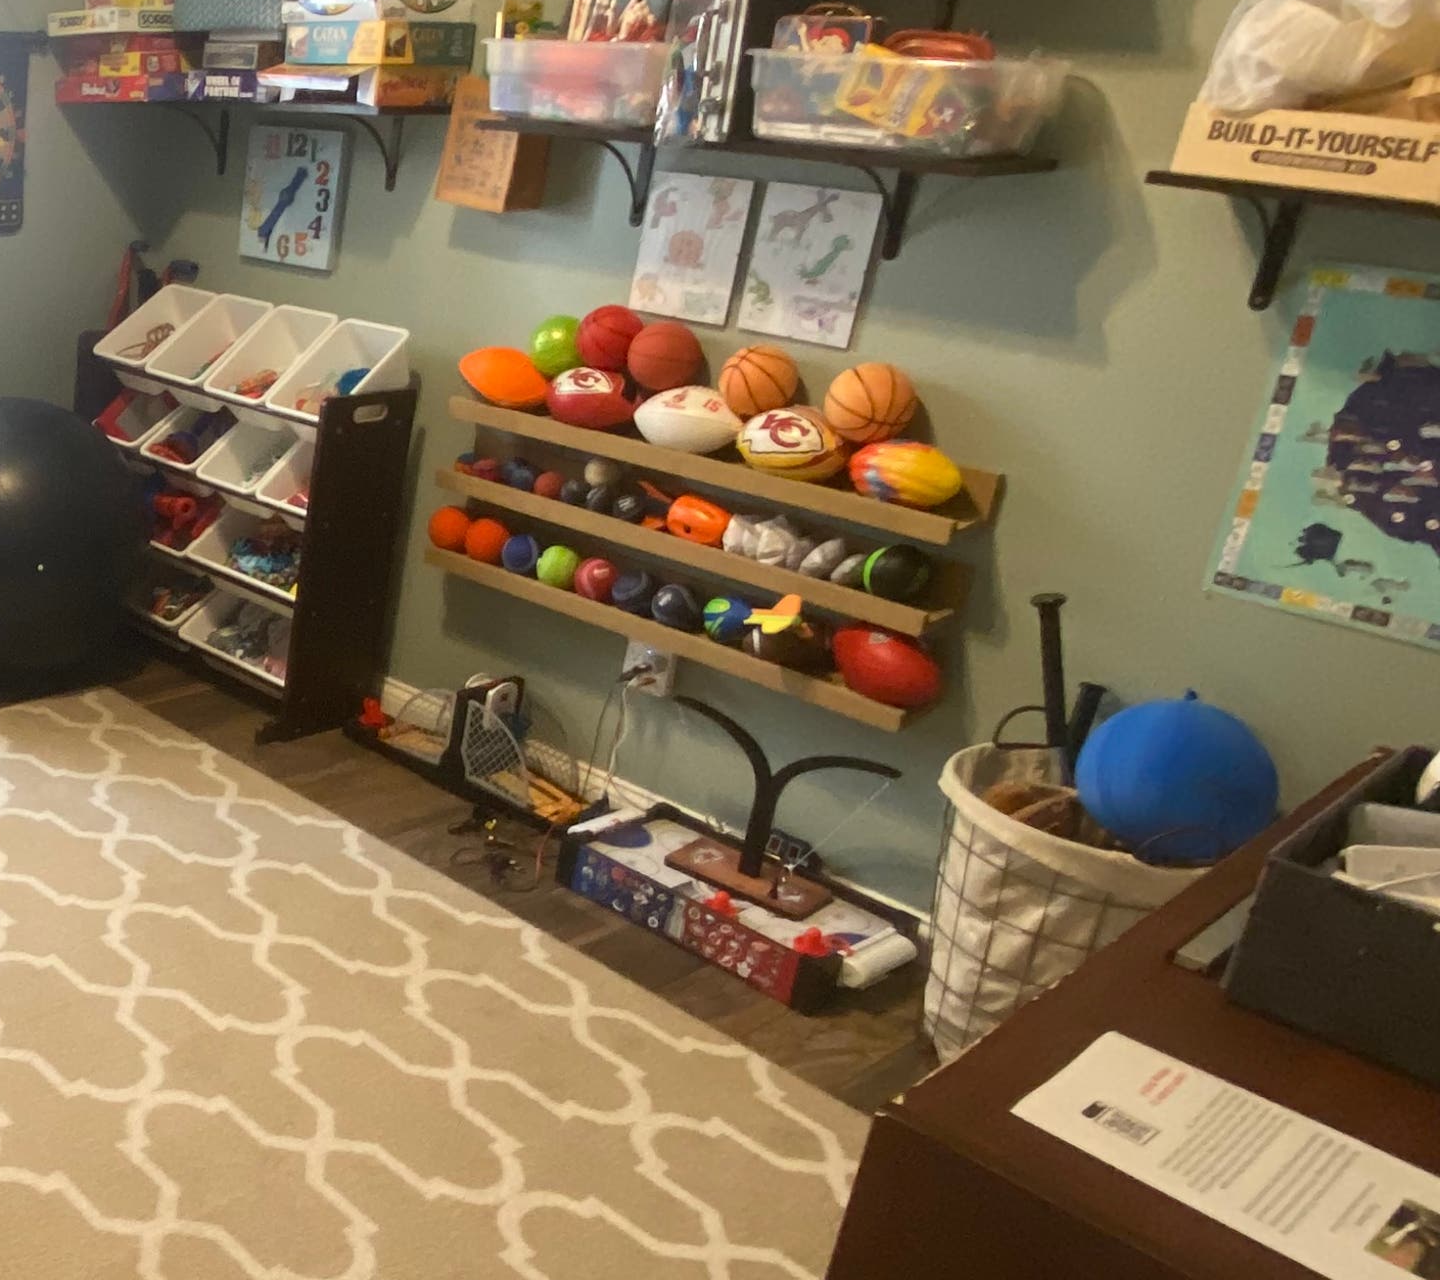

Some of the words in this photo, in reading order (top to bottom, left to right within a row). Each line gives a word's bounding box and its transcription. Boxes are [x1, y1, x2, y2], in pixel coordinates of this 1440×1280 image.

[286, 132, 308, 157] 12
[310, 138, 317, 162] 1
[1207, 120, 1440, 163] BUILD-IT-YOURSELF
[315, 160, 330, 186] 2
[316, 188, 330, 212] 3
[308, 216, 323, 239] 4
[277, 234, 290, 258] 6
[295, 232, 308, 256] 5
[760, 413, 810, 448] KC
